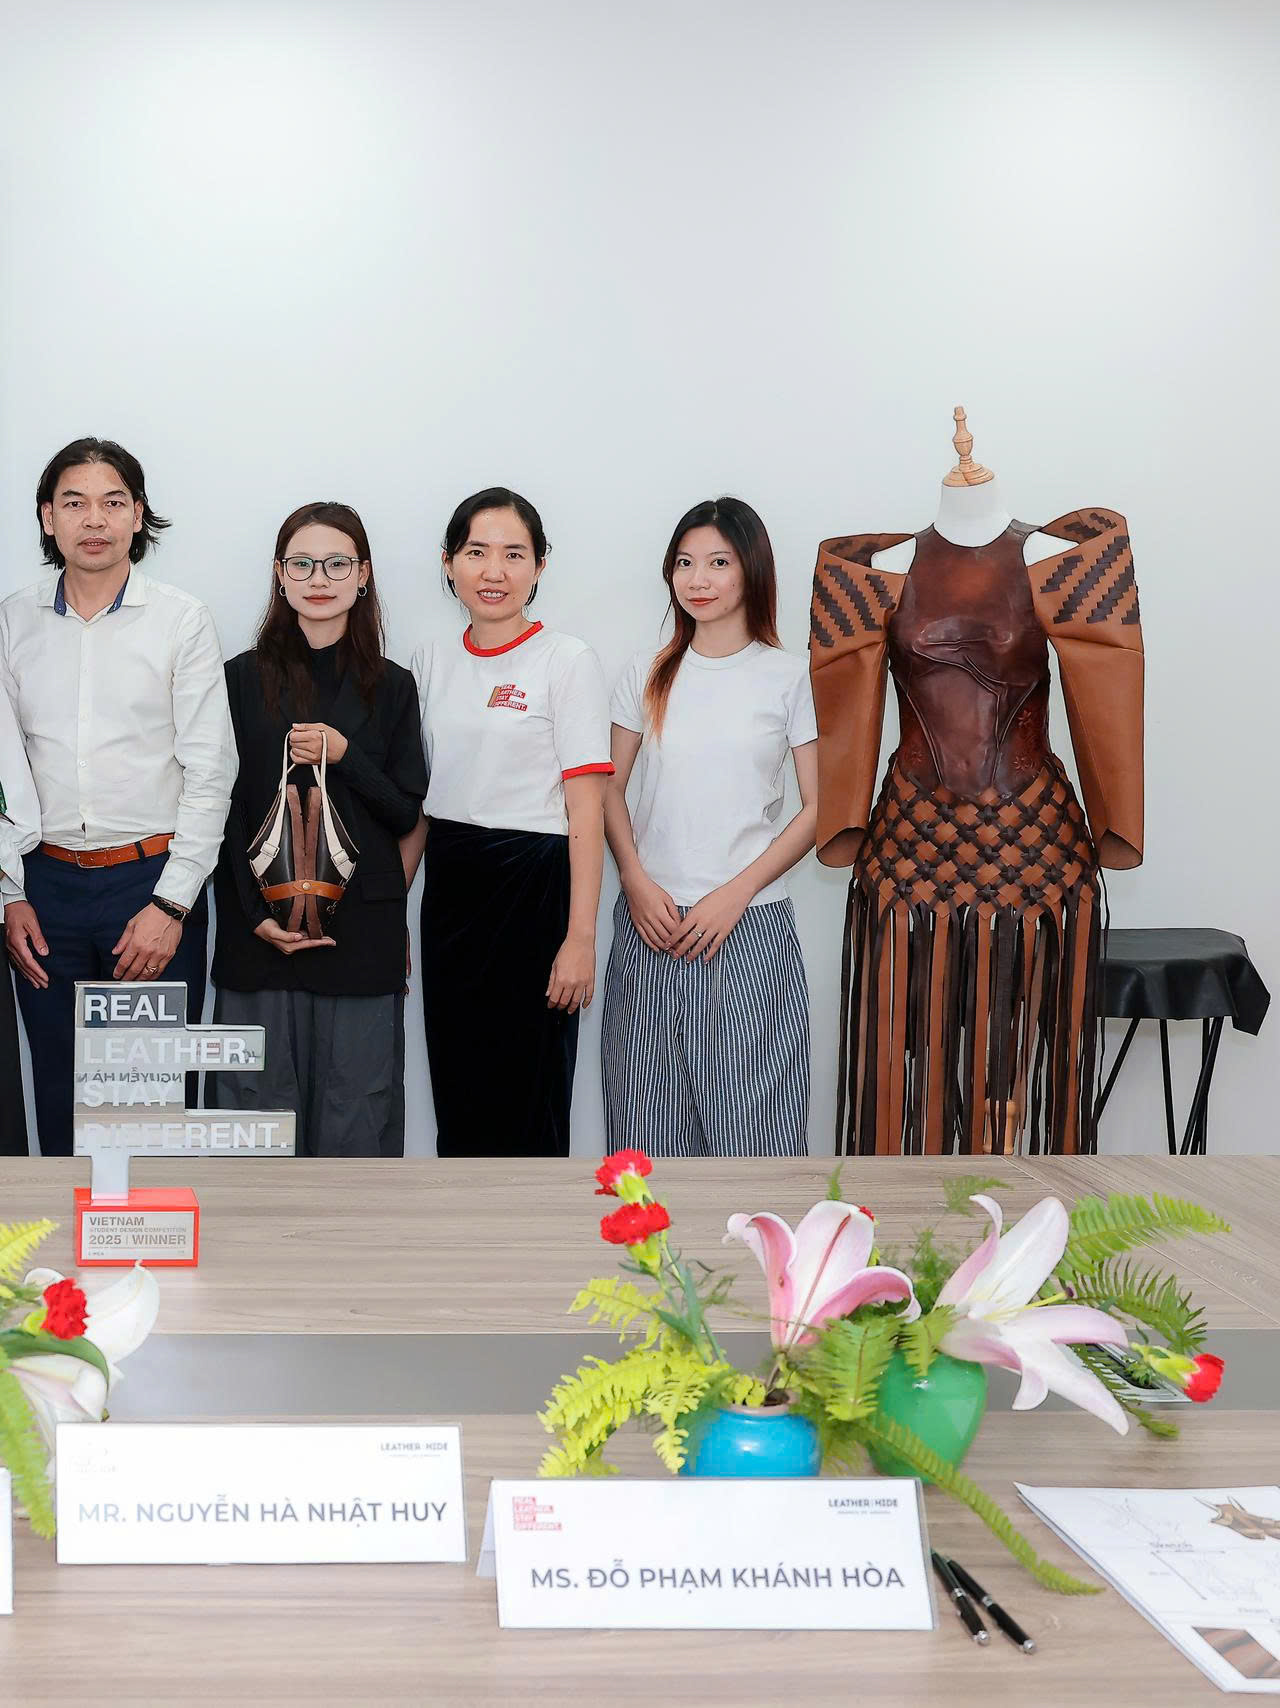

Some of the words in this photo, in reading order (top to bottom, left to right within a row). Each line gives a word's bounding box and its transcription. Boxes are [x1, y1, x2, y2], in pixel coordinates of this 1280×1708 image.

[84, 994, 178, 1022] REAL
[84, 1037, 256, 1064] LEATHER.
[82, 1080, 174, 1107] STAY
[83, 1122, 287, 1149] DIFFERENT.
[89, 1216, 145, 1226] VIETNAM
[89, 1234, 122, 1245] 2025
[132, 1234, 187, 1245] WINNER
[79, 1503, 126, 1522] MR.
[136, 1494, 249, 1522] NGUYỄN
[260, 1497, 299, 1522] HÀ
[308, 1497, 382, 1528] NHẬT
[392, 1502, 447, 1521] HUY
[828, 1499, 870, 1507] LEATHER
[531, 1568, 579, 1589] MS.
[587, 1558, 630, 1589] ĐỖ
[640, 1568, 722, 1594] PHẠM
[732, 1562, 832, 1588] KHÁNH
[842, 1561, 905, 1588] HÒA
